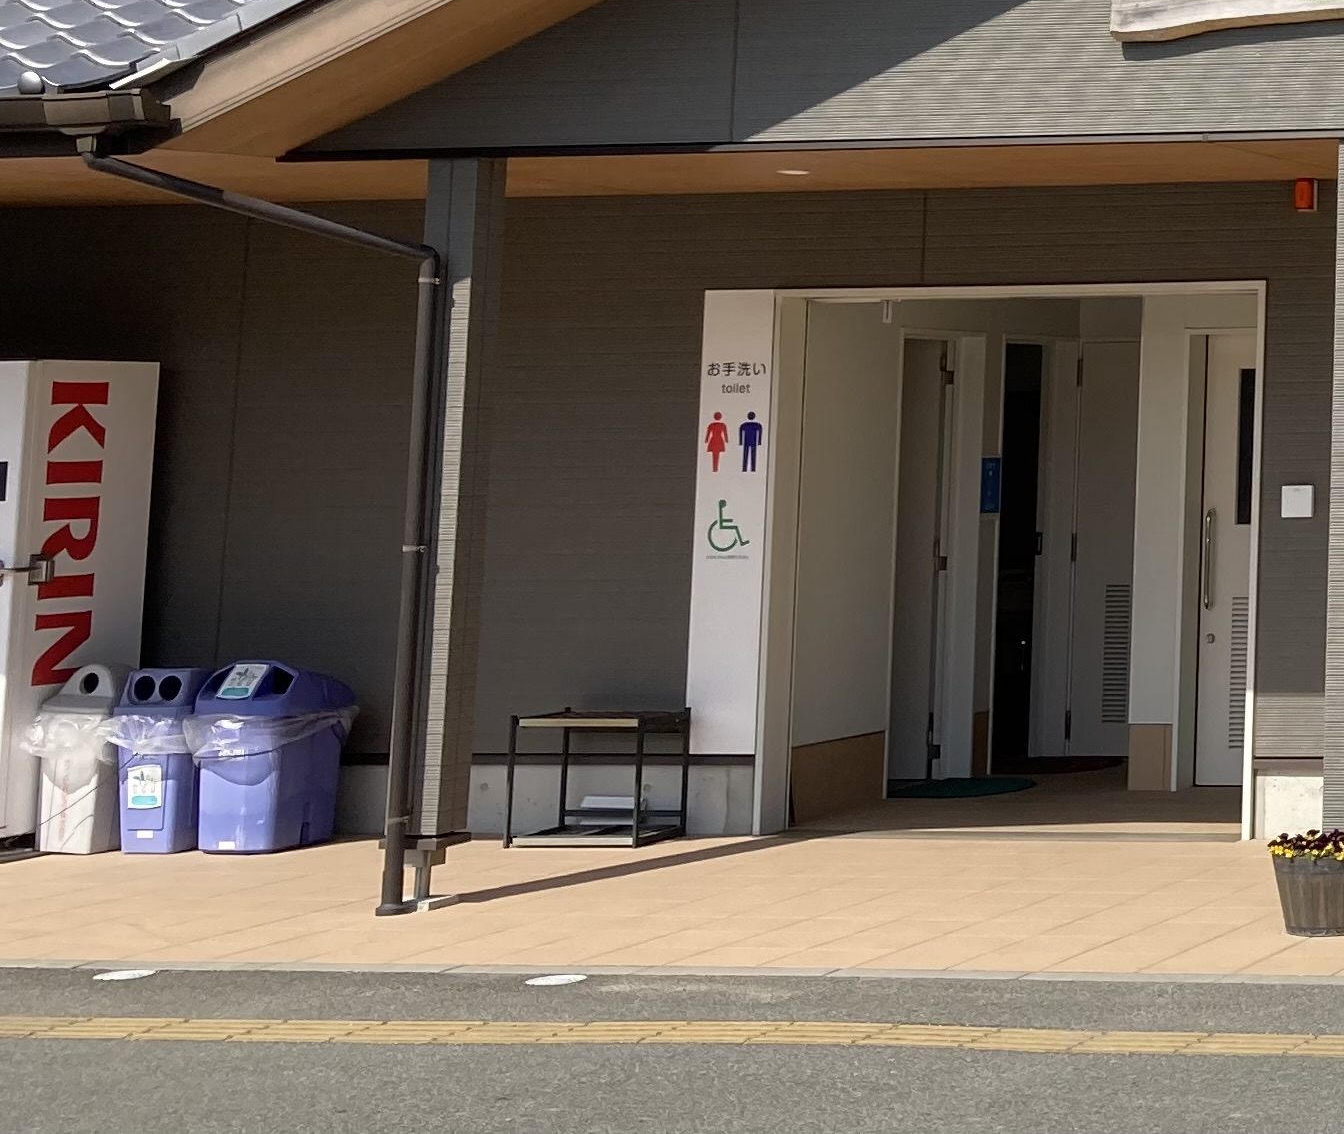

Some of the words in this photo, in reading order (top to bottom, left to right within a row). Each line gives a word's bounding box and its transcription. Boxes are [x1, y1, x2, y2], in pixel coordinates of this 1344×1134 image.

[706, 361, 767, 377] お手洗い
[721, 382, 751, 394] toilet
[31, 381, 110, 687] KIRIN
